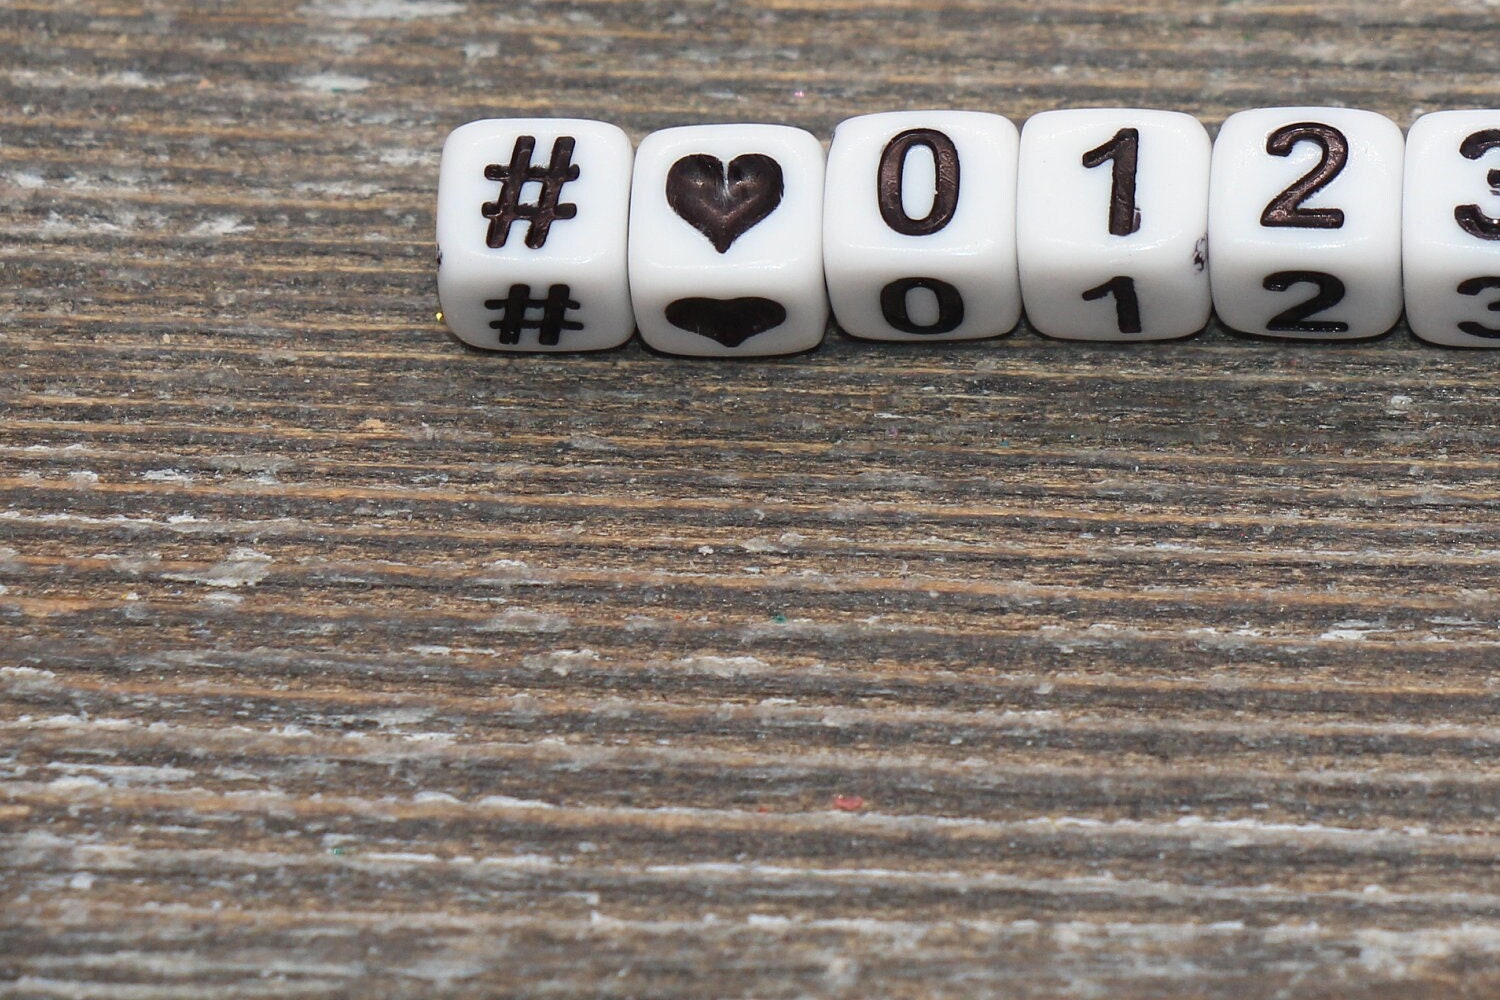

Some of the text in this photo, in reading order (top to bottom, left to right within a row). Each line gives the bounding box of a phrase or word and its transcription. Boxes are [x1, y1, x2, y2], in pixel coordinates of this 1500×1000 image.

[479, 134, 582, 251] #
[875, 126, 962, 238] 0
[1080, 126, 1143, 238] 1
[1258, 120, 1350, 231] 2
[485, 285, 584, 345] #
[880, 278, 965, 334] 0
[1082, 277, 1142, 333] 1
[1262, 270, 1349, 332] 2
